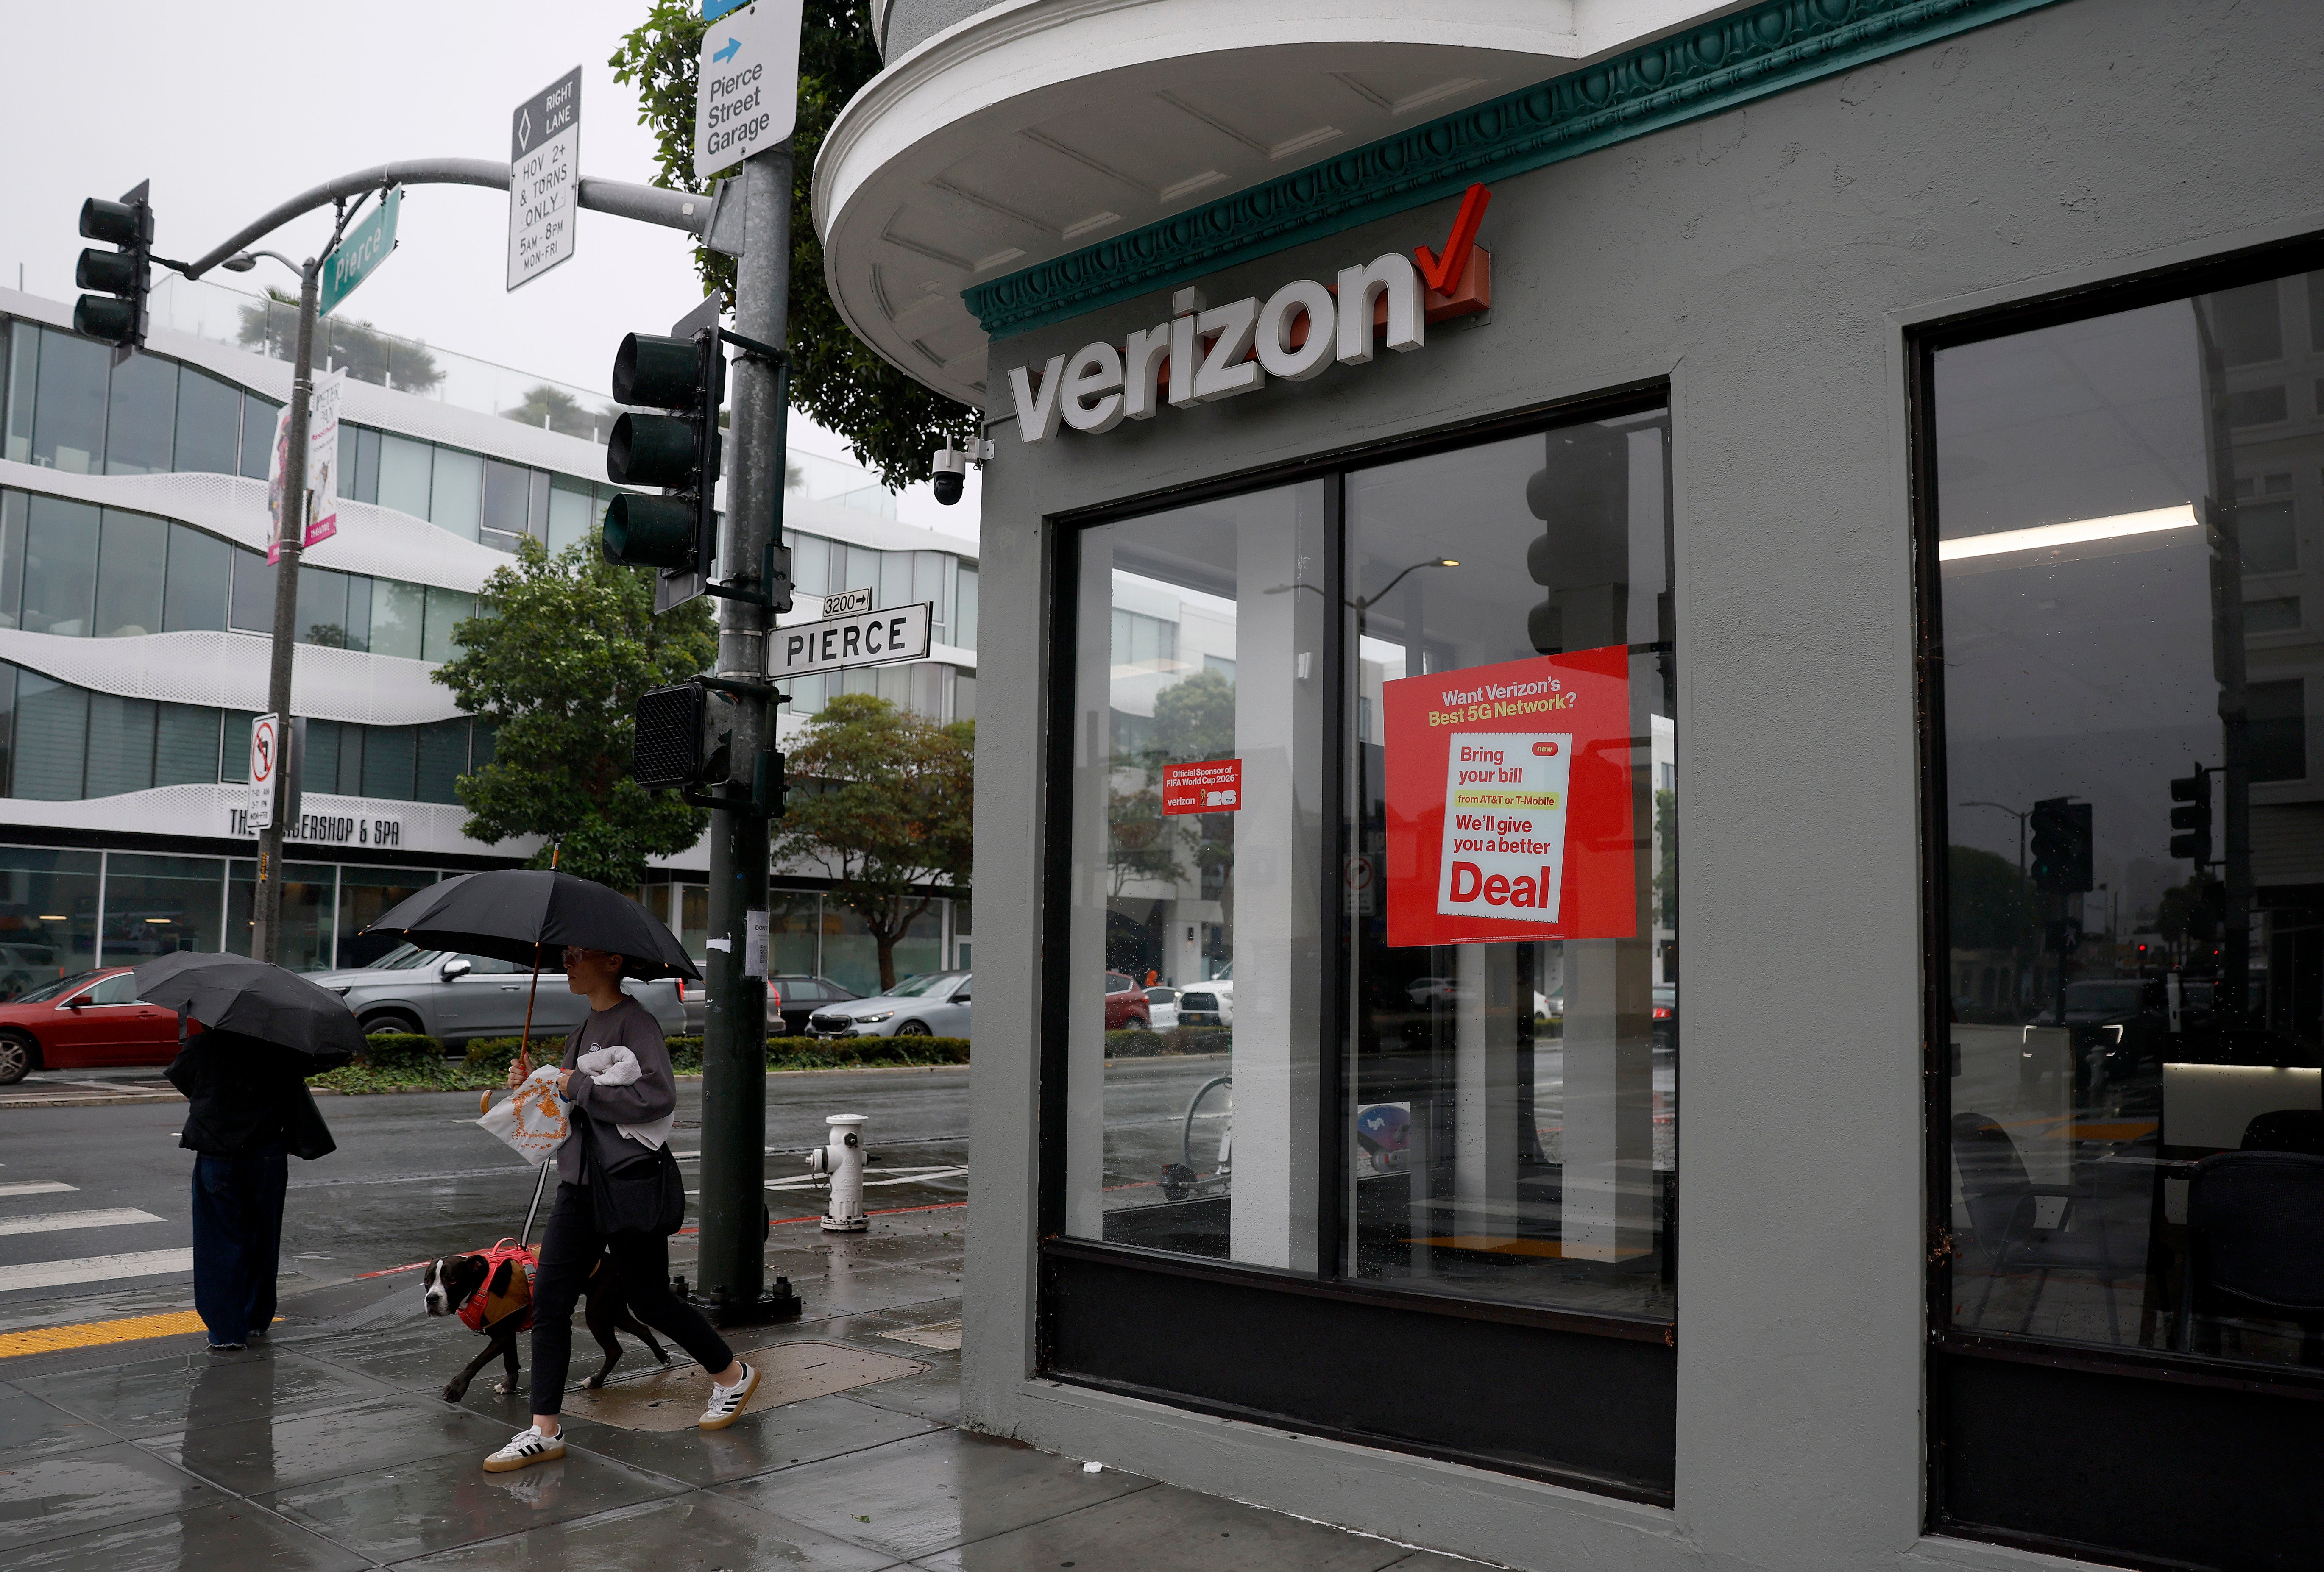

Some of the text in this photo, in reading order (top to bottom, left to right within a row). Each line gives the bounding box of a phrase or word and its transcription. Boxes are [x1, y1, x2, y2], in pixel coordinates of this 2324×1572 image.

[546, 81, 573, 112] RIGHT
[710, 64, 762, 103] Pierce
[546, 104, 571, 134] LANE
[708, 86, 761, 128] Street
[708, 113, 769, 155] Garage
[523, 144, 565, 181] HOV 2+
[520, 164, 567, 206] & TURNS
[526, 192, 558, 227] ONLY
[334, 227, 381, 292] Pierce
[524, 240, 557, 271] MON-FRI
[1007, 252, 1424, 444] verizon
[825, 594, 855, 614] 3200
[787, 617, 906, 667] PIERCE
[1442, 676, 1561, 707] Want Verizon's
[1429, 692, 1577, 727] Best 5G Network?
[1460, 746, 1504, 765] Bring
[1166, 779, 1182, 787] FIFA
[1182, 777, 1201, 785] World
[1201, 776, 1215, 785] Cup
[1173, 765, 1232, 778] Official Sponsor of
[1459, 767, 1523, 785] your bill
[1167, 797, 1195, 807] verizon
[1458, 794, 1479, 803] from
[1480, 795, 1504, 804] AT&T
[1516, 796, 1555, 806] T-Mobile
[230, 809, 399, 846] TH ERSHOP & SPA
[1455, 814, 1532, 835] We'll give
[1453, 837, 1551, 854] you a better
[1449, 861, 1551, 909] Deal
[1367, 1117, 1385, 1130] lyft
